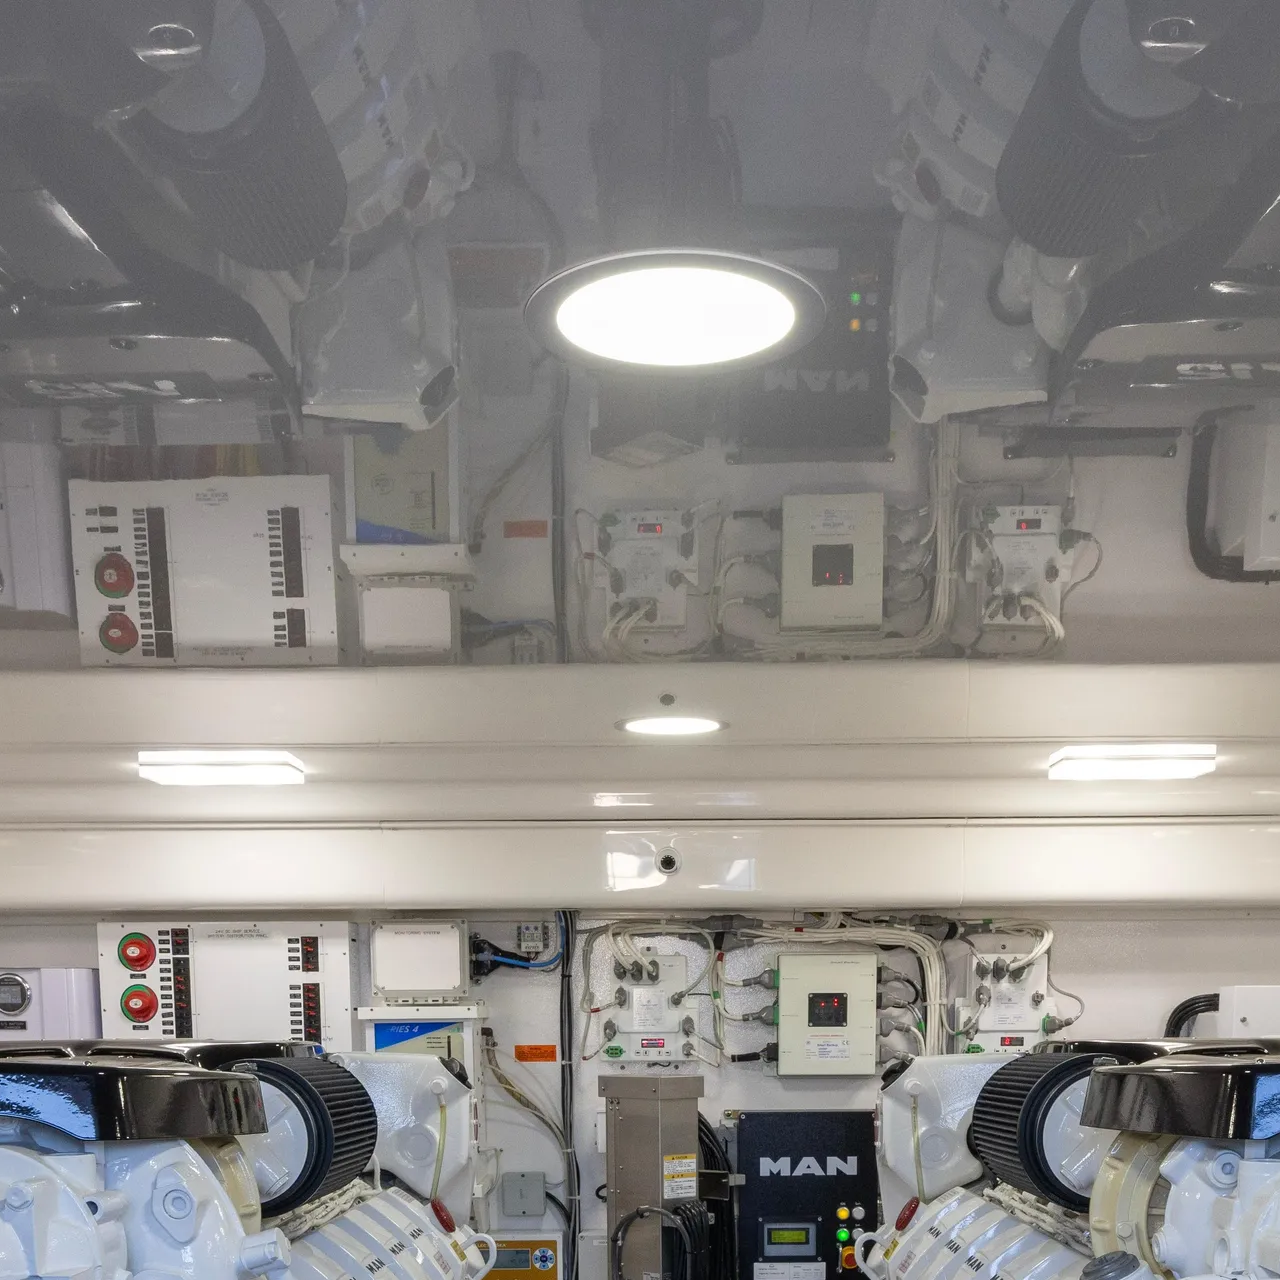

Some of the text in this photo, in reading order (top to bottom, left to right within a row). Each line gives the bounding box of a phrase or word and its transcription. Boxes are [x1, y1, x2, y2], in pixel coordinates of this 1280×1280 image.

[760, 1156, 857, 1176] MAN
[410, 1227, 424, 1240] MAN
[927, 1226, 941, 1239] MAN
[389, 1241, 406, 1256] MAN
[944, 1239, 961, 1254] MAN
[366, 1257, 386, 1275] MAN
[965, 1255, 985, 1272] MAN
